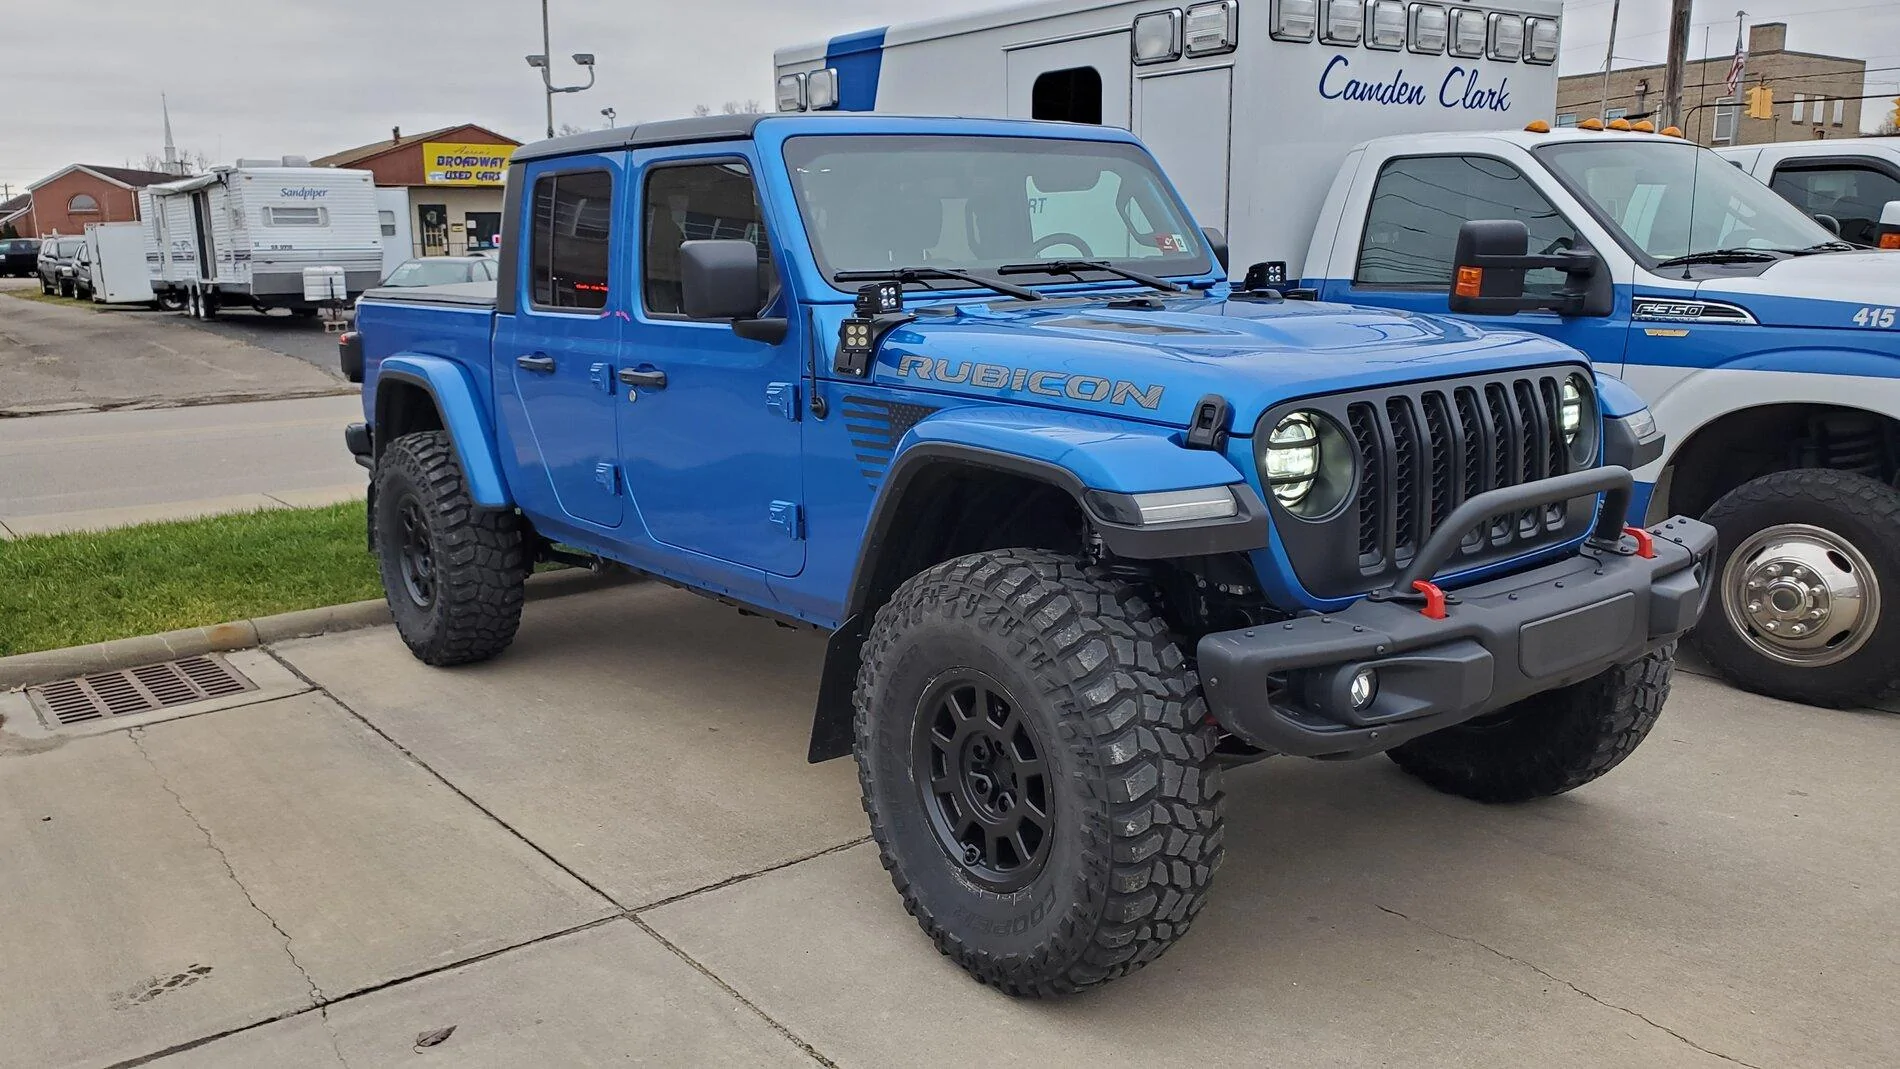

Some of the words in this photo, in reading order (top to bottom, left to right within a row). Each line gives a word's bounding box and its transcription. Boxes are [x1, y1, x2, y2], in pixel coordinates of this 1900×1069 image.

[1319, 54, 1426, 106] Camden
[1439, 66, 1512, 112] Clark
[437, 156, 505, 168] BROADWAY
[446, 171, 472, 180] USED
[476, 172, 501, 181] CARS
[280, 186, 328, 200] Sandpiper
[1852, 307, 1896, 328] 415
[897, 355, 1165, 410] RUBICON
